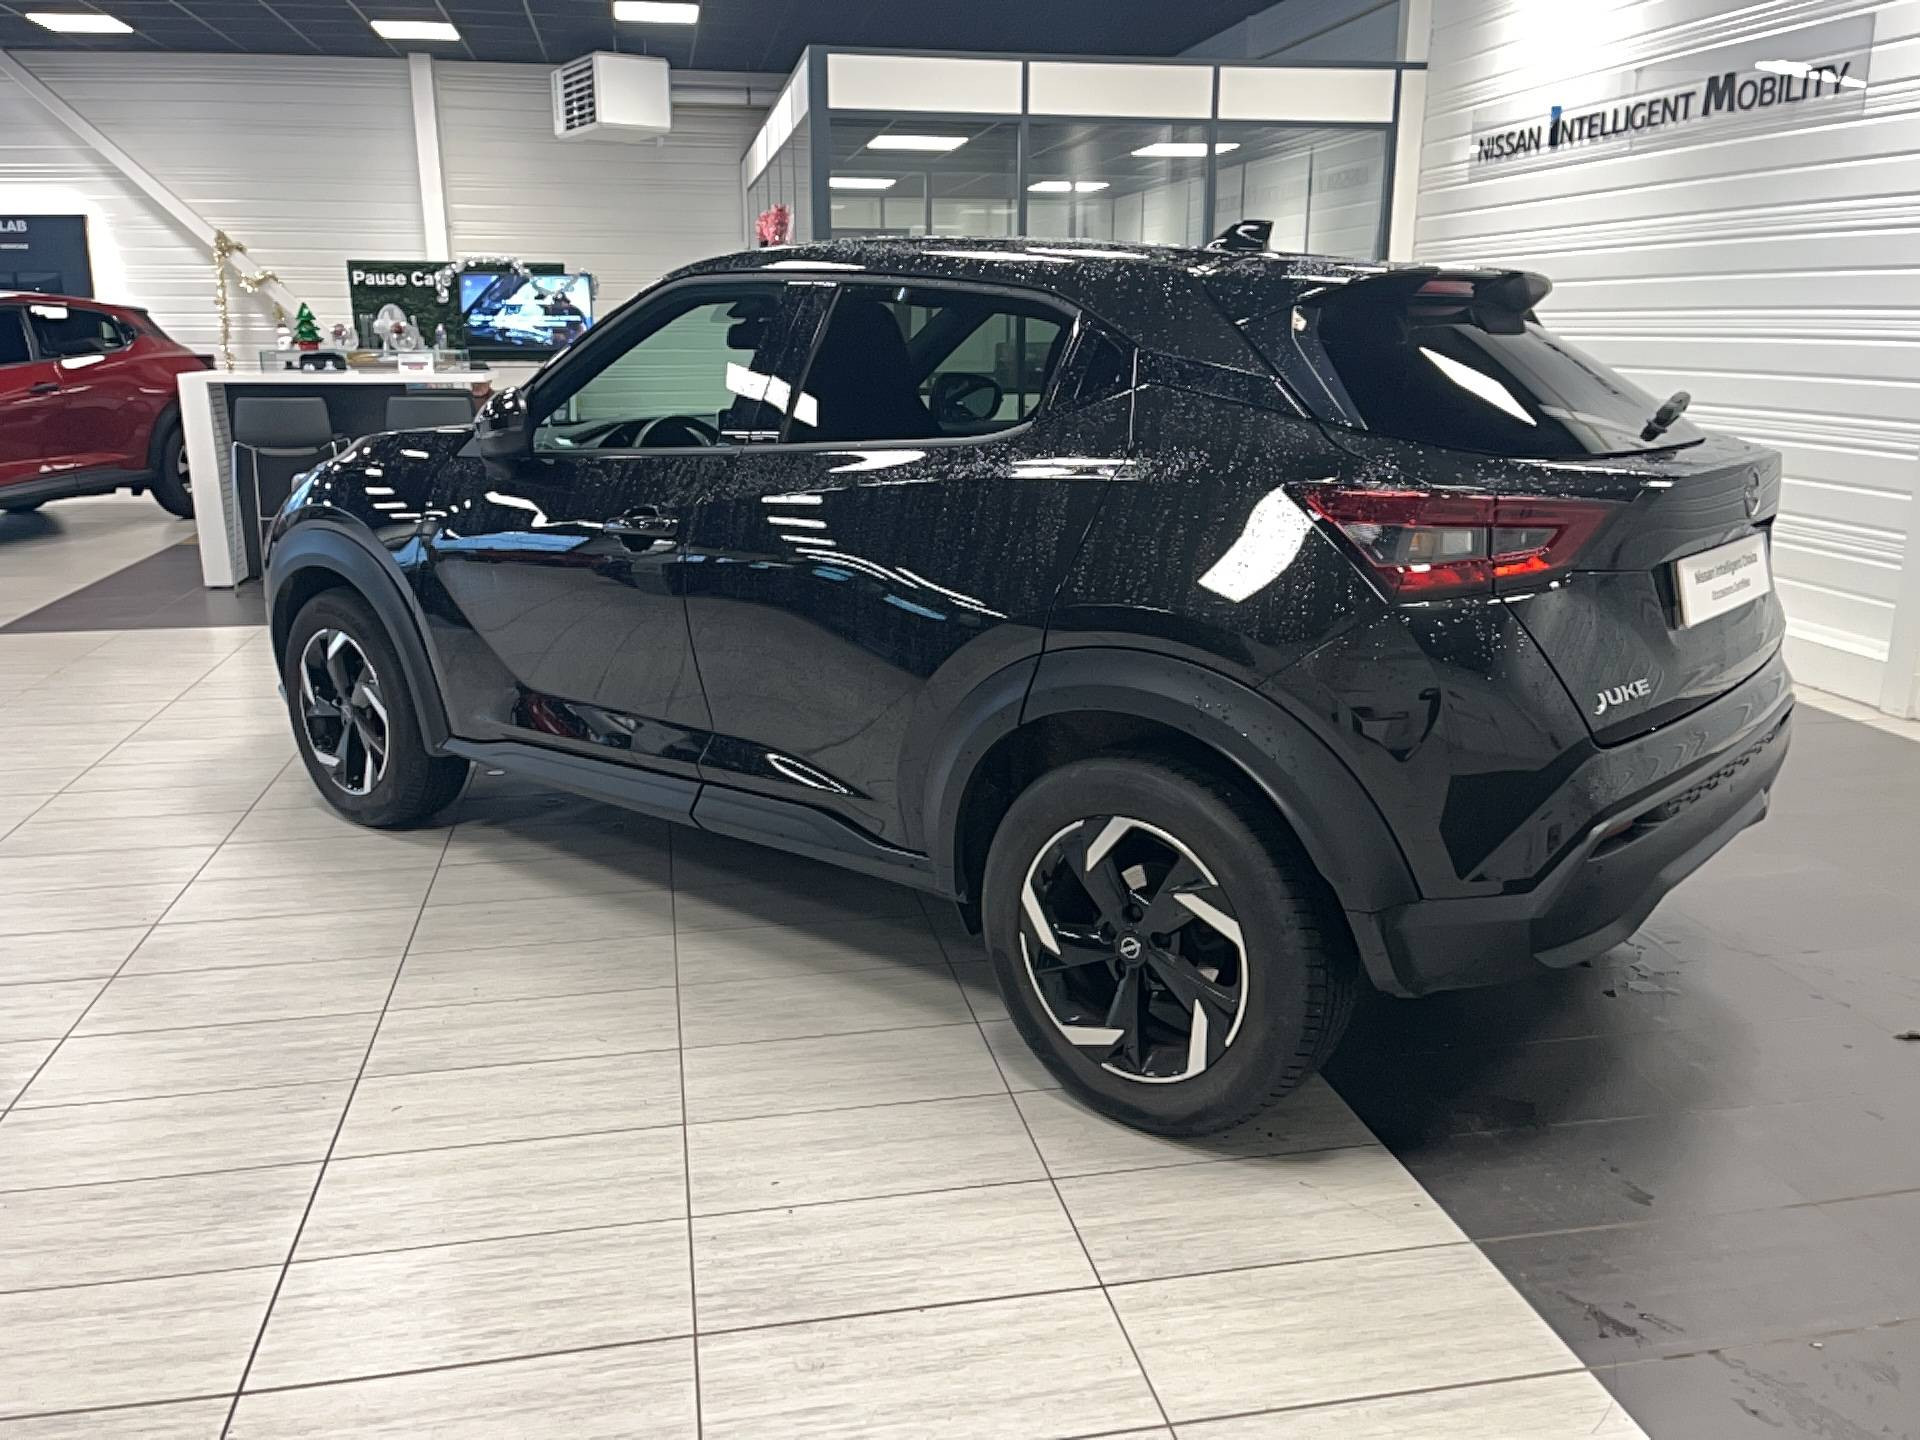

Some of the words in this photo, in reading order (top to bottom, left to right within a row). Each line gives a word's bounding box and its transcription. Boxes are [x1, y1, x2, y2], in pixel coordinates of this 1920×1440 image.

[1478, 126, 1542, 162] NISSAN
[1549, 91, 1697, 147] INTELLIGENT
[1702, 61, 1851, 117] MOBILITY
[352, 270, 407, 286] Pause
[411, 271, 452, 287] Ca
[1593, 678, 1651, 716] JUKE
